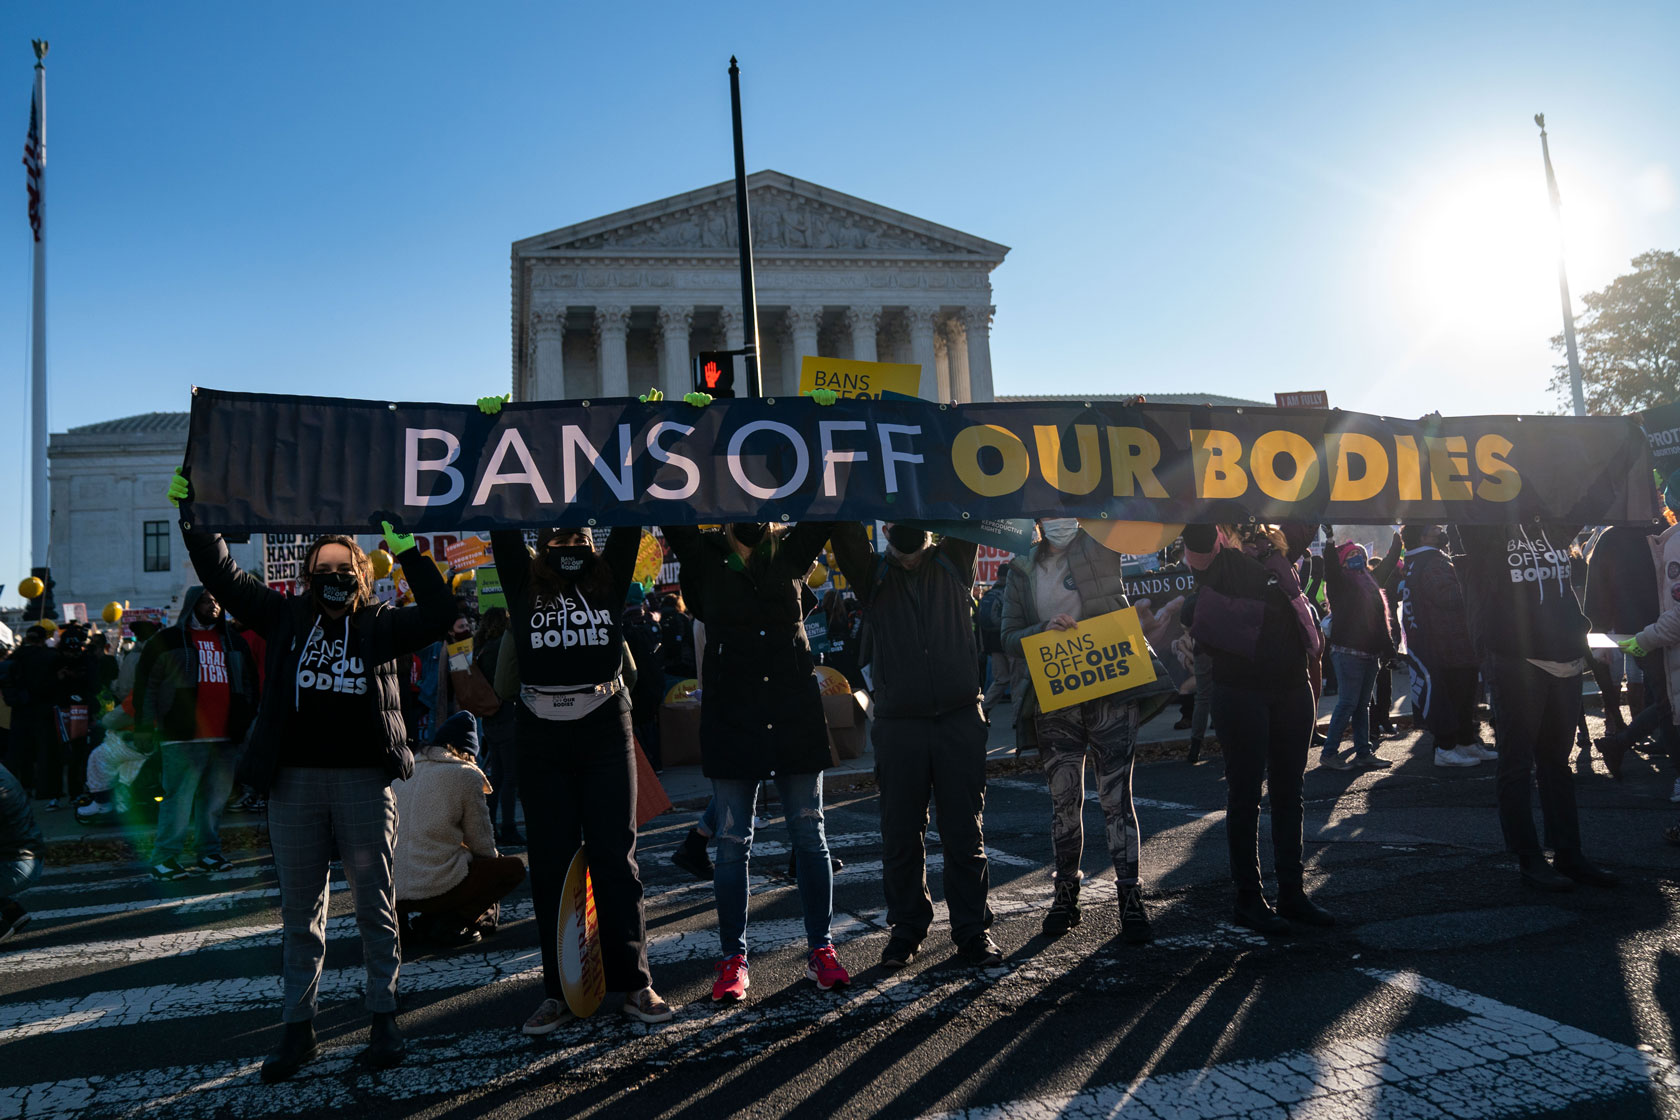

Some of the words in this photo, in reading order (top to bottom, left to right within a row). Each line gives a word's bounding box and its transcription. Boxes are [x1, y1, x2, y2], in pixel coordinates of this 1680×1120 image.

[814, 370, 870, 391] BANS
[1287, 395, 1300, 407] AM
[1300, 393, 1323, 406] FULLY
[1647, 427, 1680, 448] PROT
[404, 421, 702, 506] BANS
[727, 420, 925, 500] OFF
[951, 424, 1170, 498] OUR
[1189, 428, 1522, 502] BODIES
[980, 525, 1001, 534] RIGHTS
[981, 519, 1022, 535] REPRODUCTIVE
[1544, 549, 1570, 564] OU
[267, 562, 296, 580] SHED
[1510, 565, 1570, 583] BODIES
[534, 595, 577, 611] BANS
[530, 610, 565, 629] OFF
[570, 609, 614, 626] OUR
[198, 640, 215, 651] THE
[530, 628, 610, 649] BODIES
[1039, 633, 1095, 663] BANS
[199, 650, 225, 667] ORAL
[331, 657, 365, 675] OU
[1044, 654, 1083, 679] OFF
[1085, 641, 1135, 667] OUR
[298, 670, 368, 695] ODIES
[1049, 659, 1130, 696] BODIES
